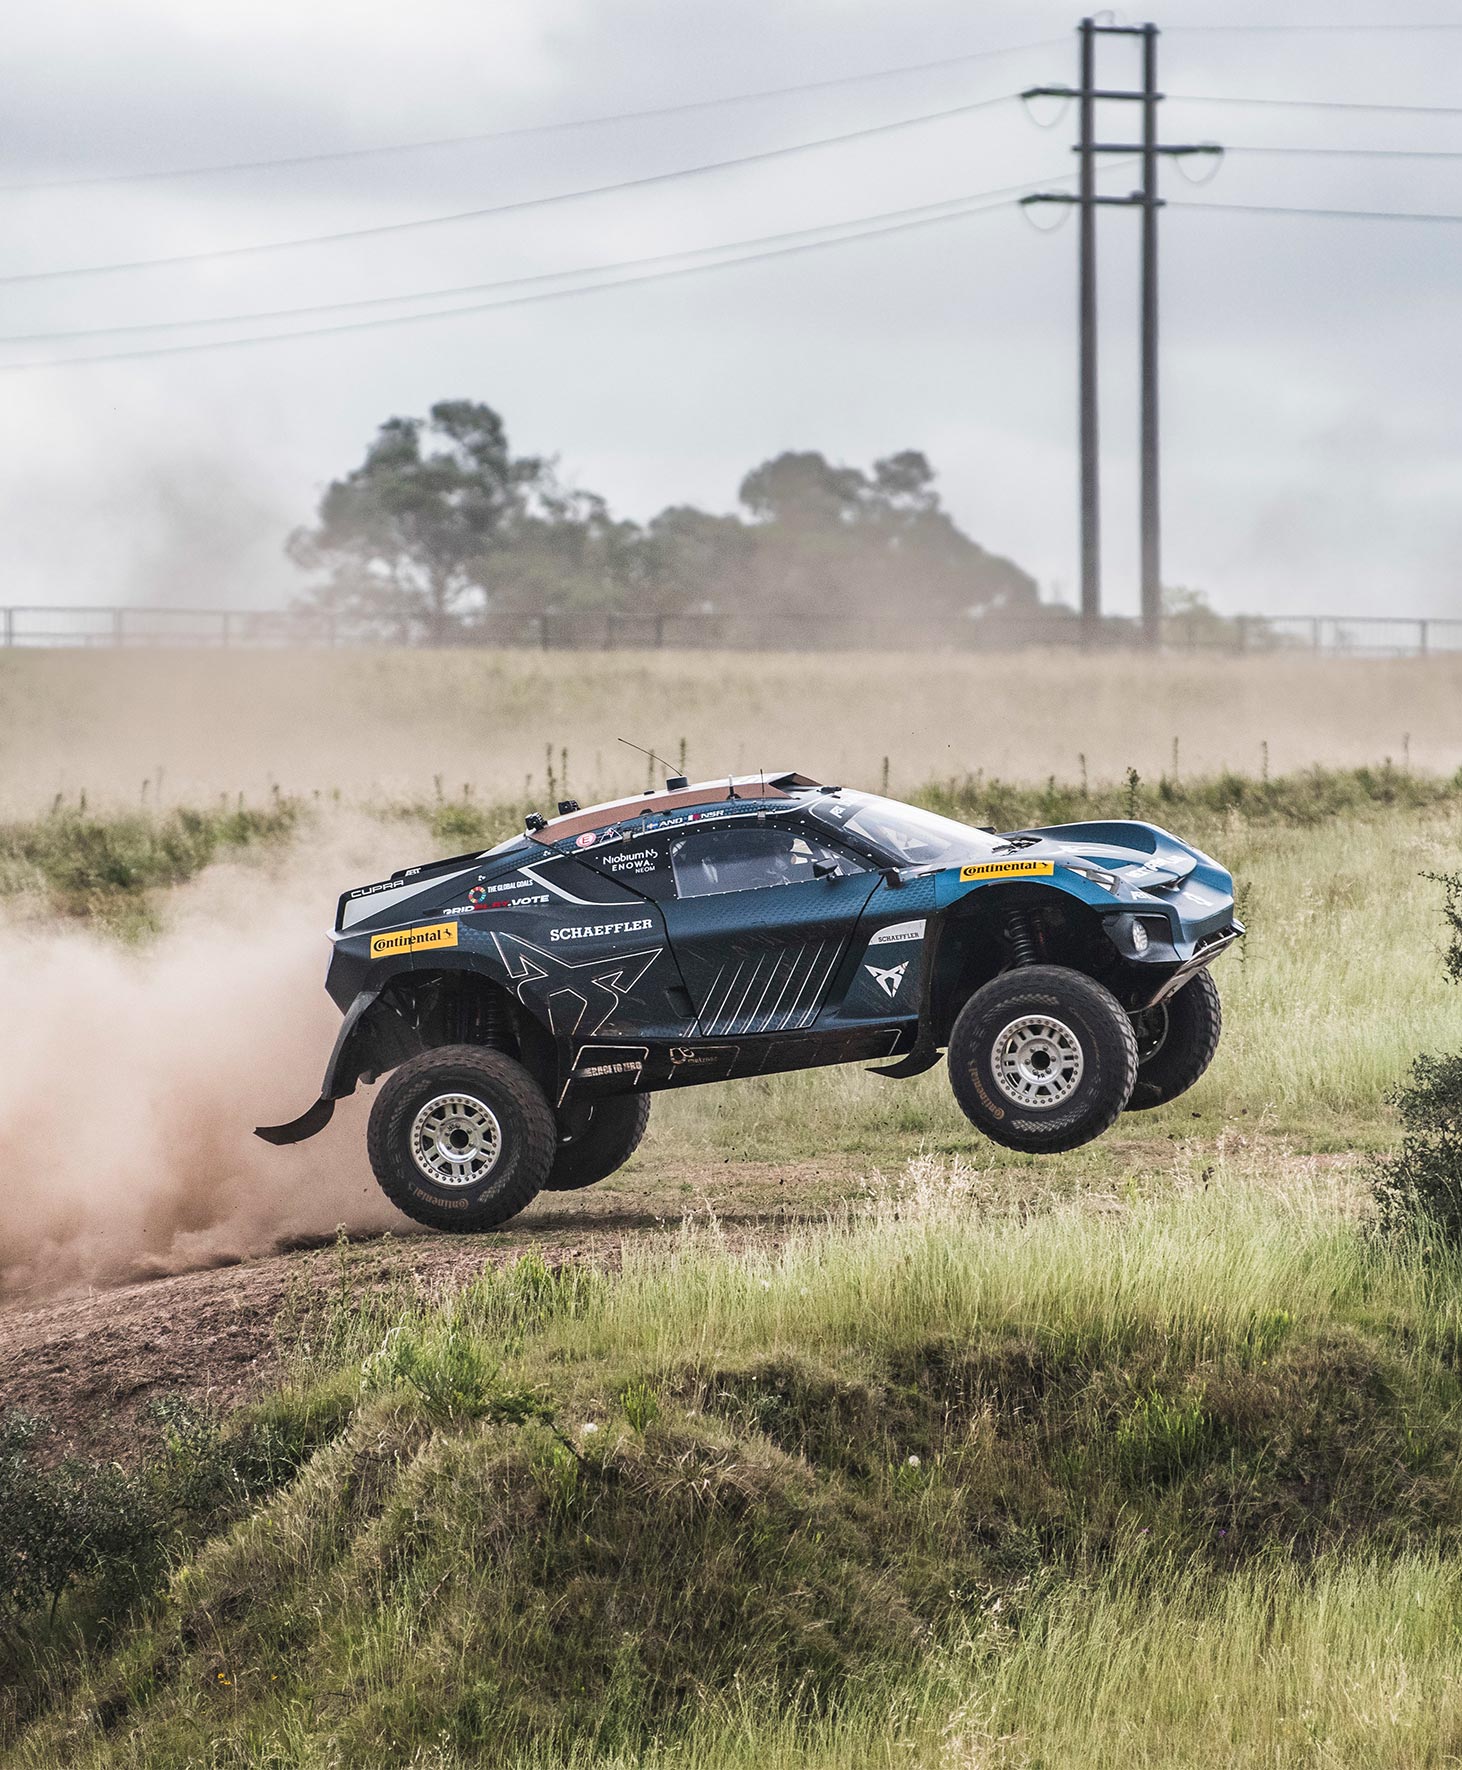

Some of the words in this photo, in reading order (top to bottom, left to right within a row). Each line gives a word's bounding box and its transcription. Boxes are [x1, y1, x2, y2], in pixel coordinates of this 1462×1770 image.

[659, 817, 683, 828] AND
[701, 810, 725, 819] NSR
[635, 865, 656, 874] NEOM
[963, 861, 1037, 877] Continental
[351, 879, 404, 898] CUPRA
[487, 885, 498, 893] THE
[497, 882, 517, 891] GLOBAL
[516, 879, 533, 888] GOALS
[550, 919, 653, 942] SCHAEFFLER
[878, 932, 920, 943] SCHAEFFLER
[373, 929, 441, 952] Continental
[968, 1067, 1006, 1120] Continental
